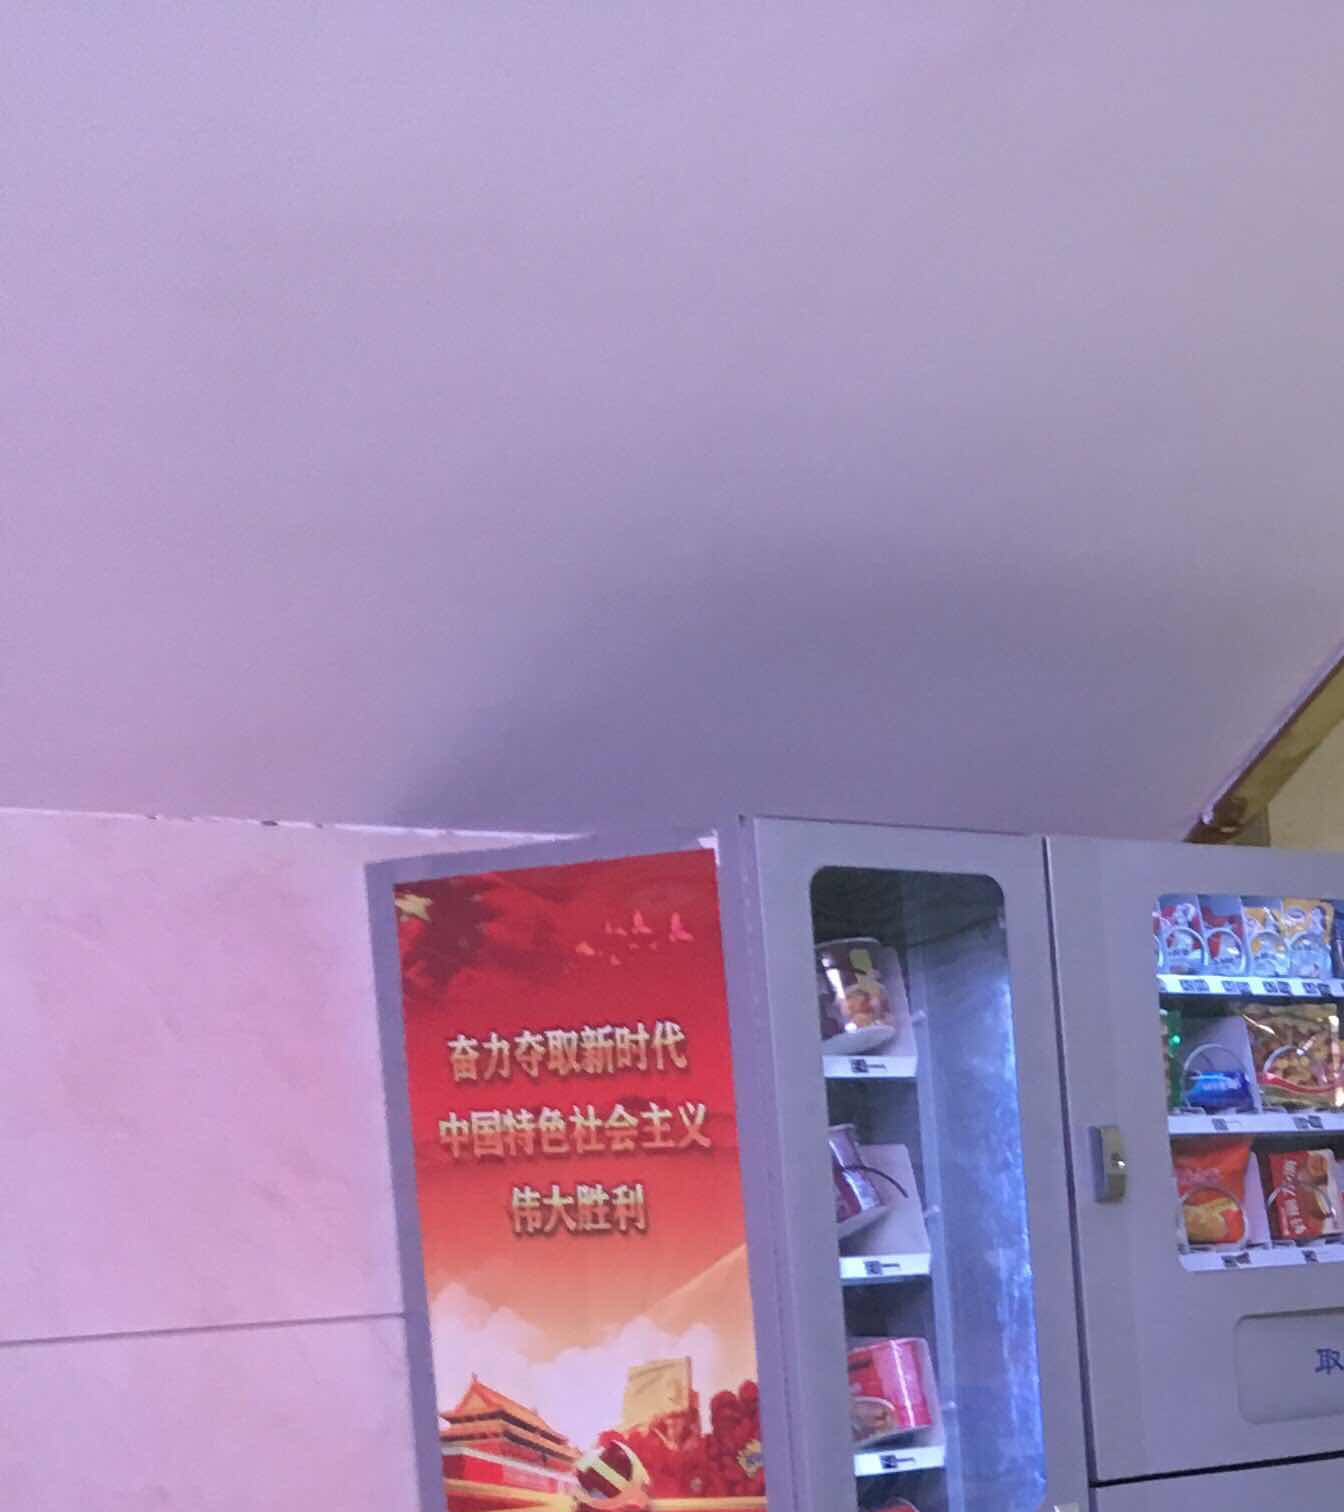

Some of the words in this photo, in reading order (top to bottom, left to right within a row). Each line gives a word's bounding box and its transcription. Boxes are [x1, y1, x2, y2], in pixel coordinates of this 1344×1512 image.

[446, 1021, 690, 1084] 奋力夺取新时代
[438, 1101, 714, 1161] 中国特色社会主义
[508, 1182, 649, 1238] 伟大胜利
